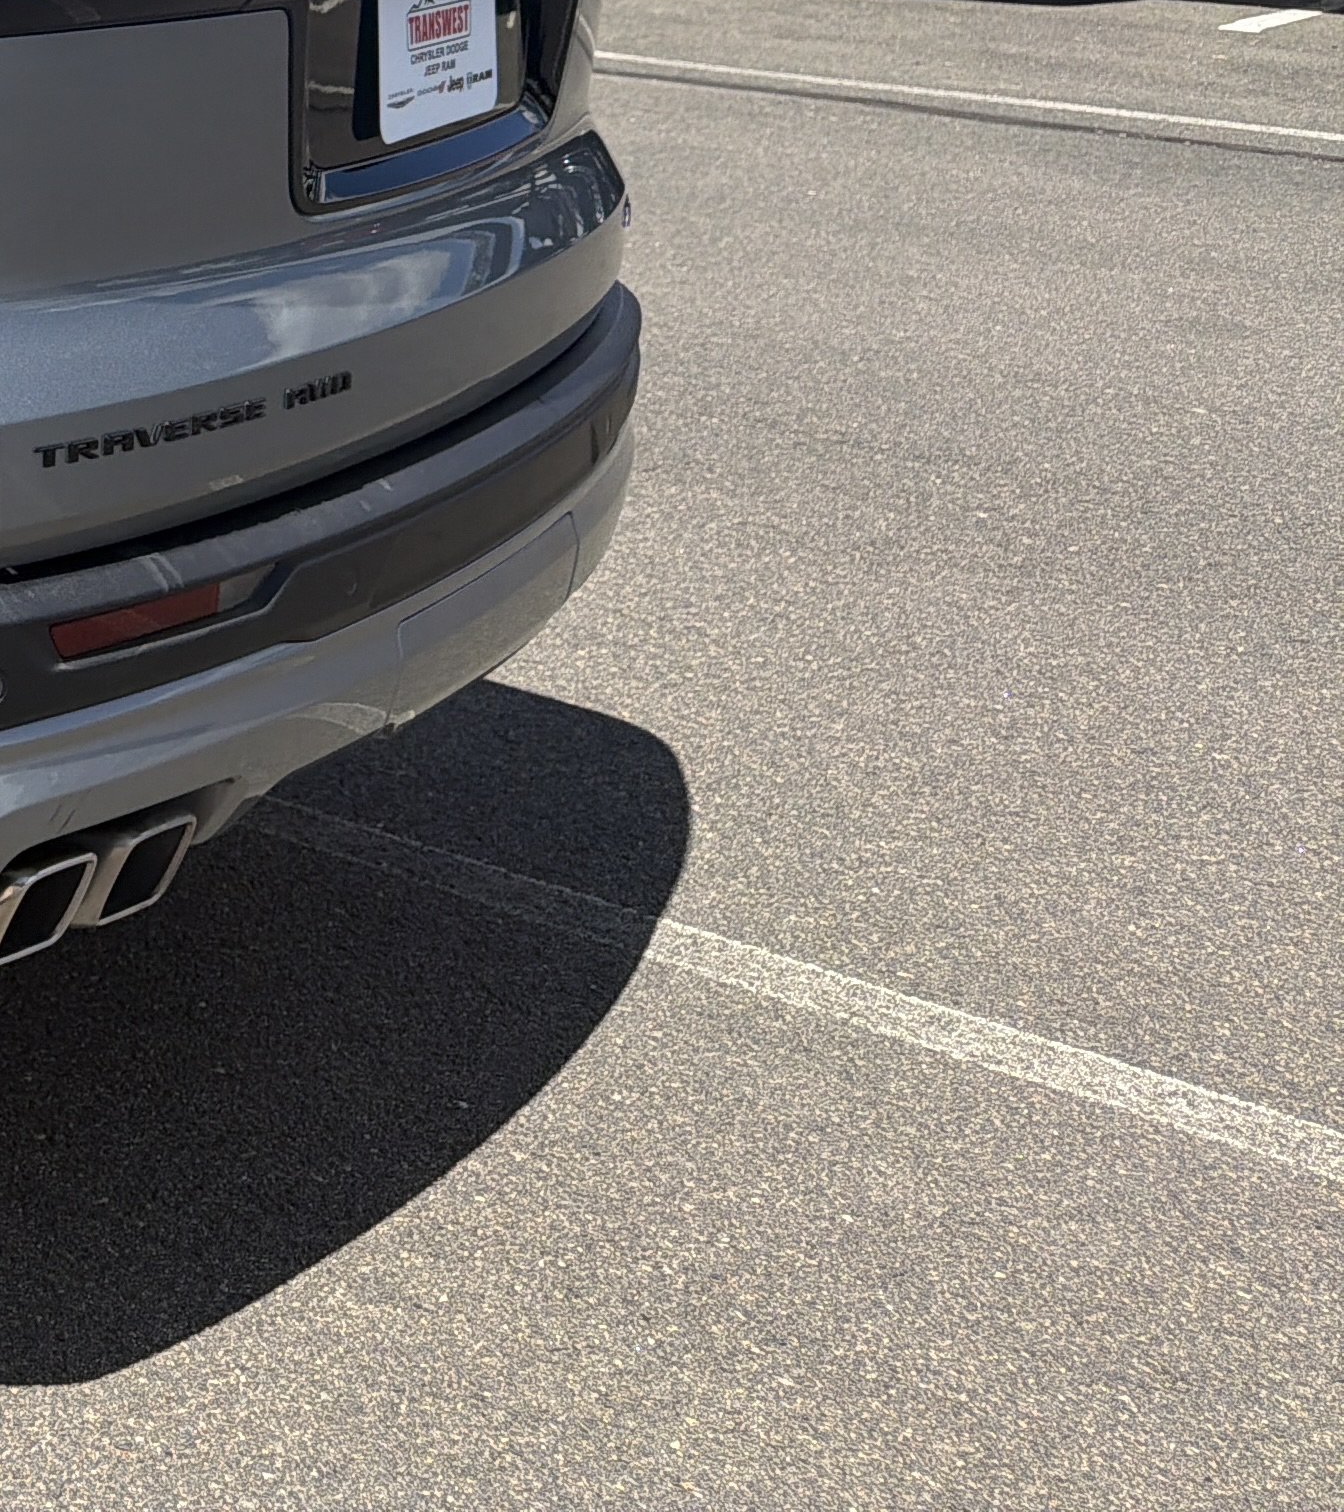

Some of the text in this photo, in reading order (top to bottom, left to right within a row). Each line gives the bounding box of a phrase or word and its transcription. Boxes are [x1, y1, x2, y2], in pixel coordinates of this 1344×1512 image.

[408, 4, 469, 45] TRANSWEST
[410, 39, 469, 65] CHRYSLER DODGE
[424, 58, 457, 77] JEEP RAM
[447, 75, 464, 93] Jeep
[471, 68, 493, 84] RAM
[32, 370, 353, 469] TRAVERSE AWD
